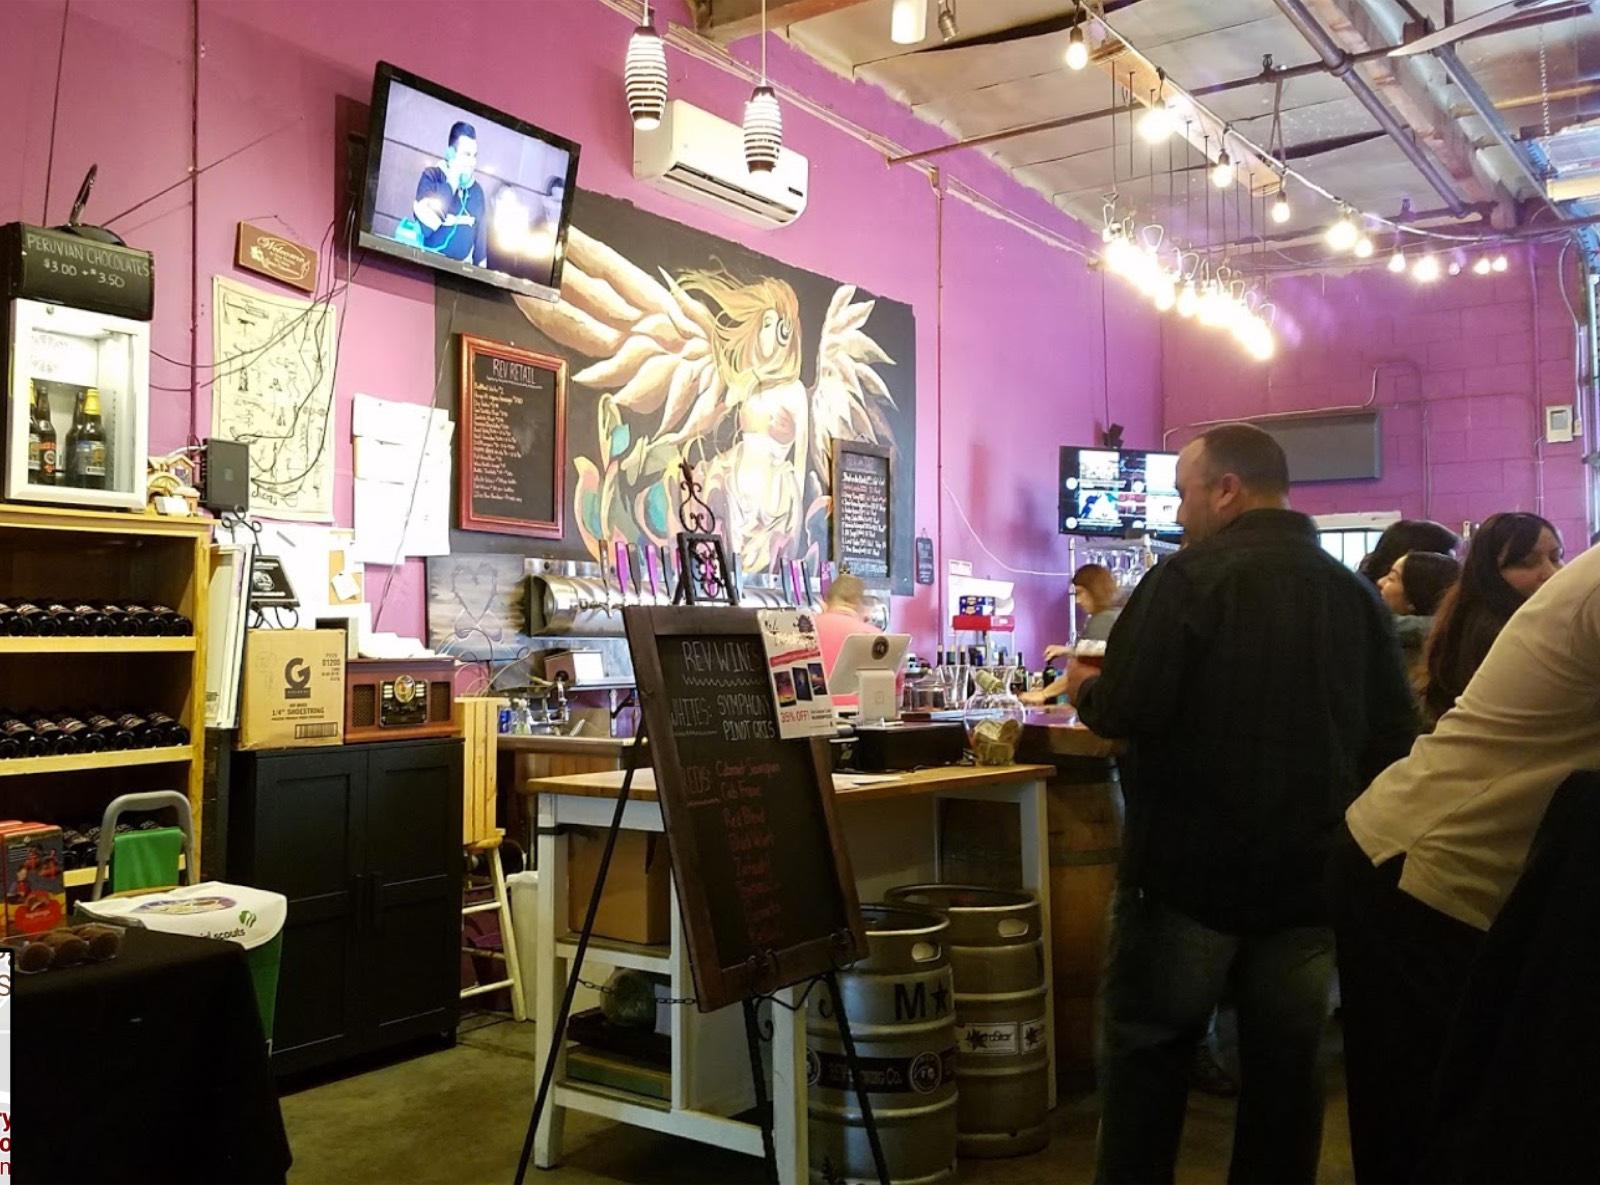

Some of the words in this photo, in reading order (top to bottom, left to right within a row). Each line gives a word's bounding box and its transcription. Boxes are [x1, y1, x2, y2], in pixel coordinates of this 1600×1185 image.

[27, 234, 84, 262] PERUVIAN
[86, 251, 150, 277] CHOCOLATES
[43, 258, 77, 276] $3.00
[681, 641, 712, 672] REV
[722, 719, 752, 741] PINOT
[752, 719, 776, 739] GRIS
[893, 981, 927, 1021] M
